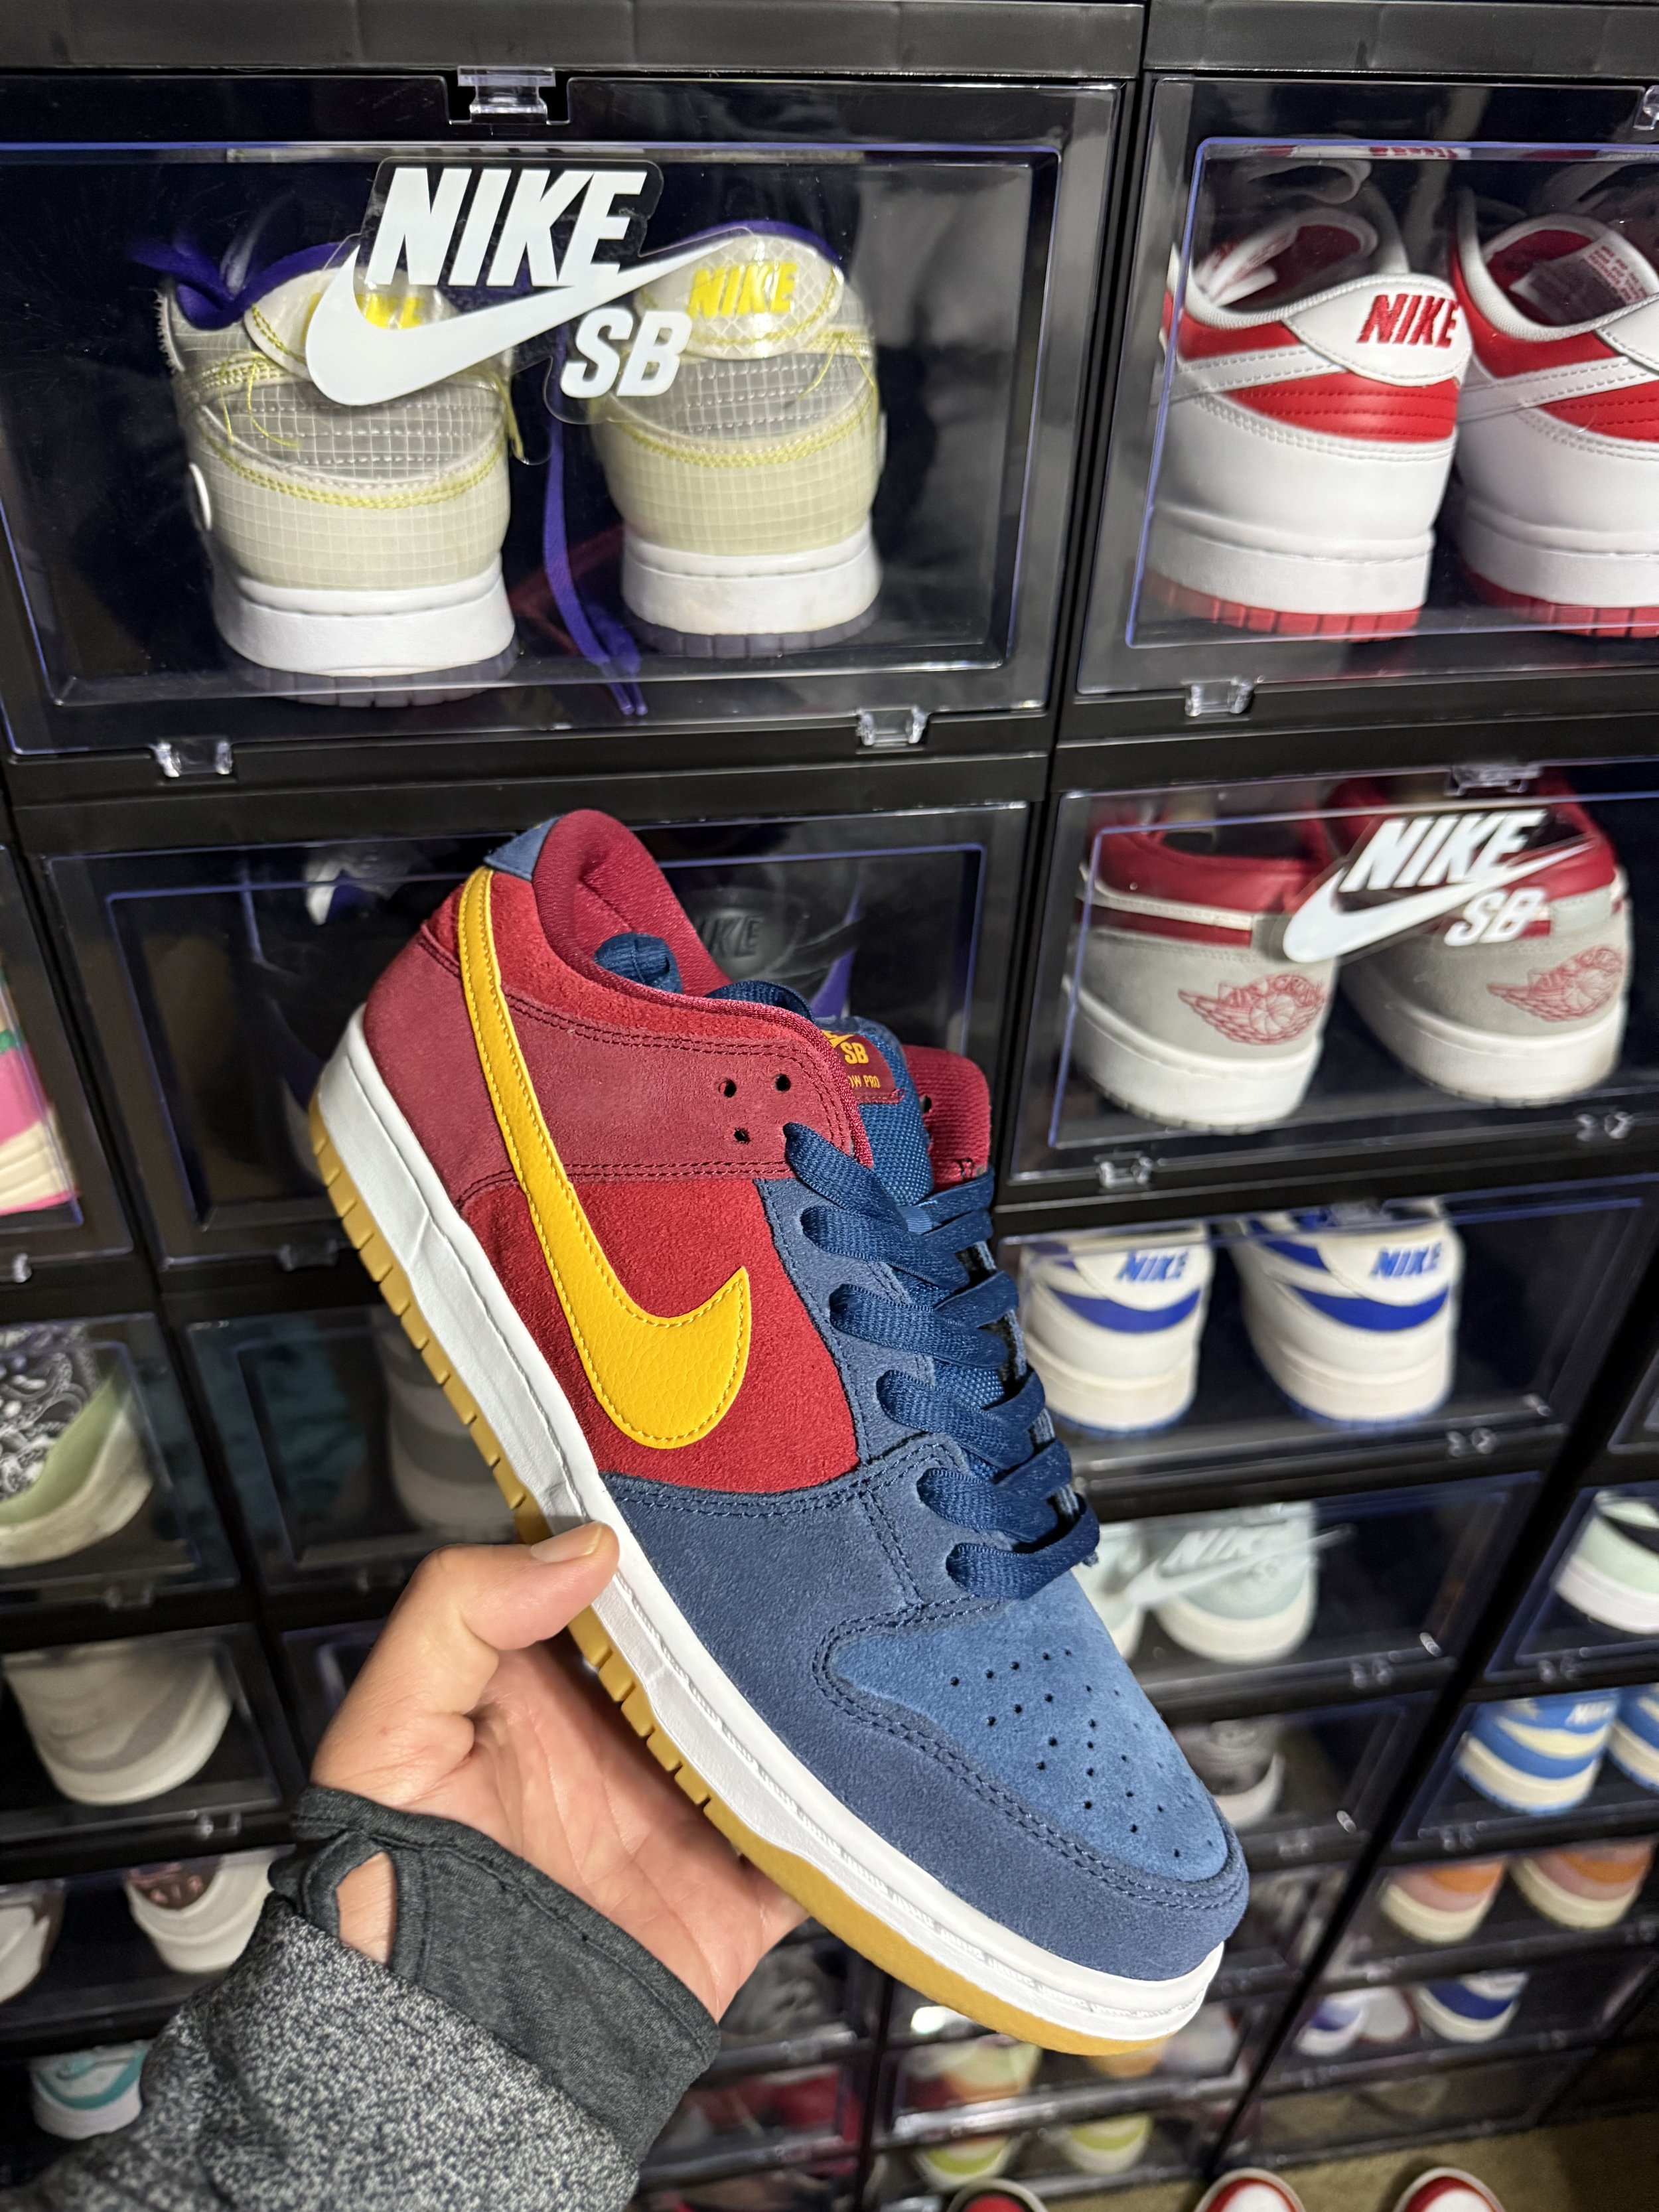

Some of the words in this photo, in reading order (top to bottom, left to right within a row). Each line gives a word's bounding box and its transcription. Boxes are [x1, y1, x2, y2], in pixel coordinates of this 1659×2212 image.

[366, 167, 647, 286] NIKE
[688, 262, 798, 319] NIKE
[1356, 293, 1458, 348] NIKE
[561, 307, 693, 399] SB
[1338, 809, 1548, 893] NIKE
[1443, 887, 1546, 947] SB
[839, 1042, 869, 1065] SB
[863, 1074, 881, 1088] PRO
[1116, 1249, 1189, 1282] NIKE
[1368, 1242, 1441, 1277] NIKE
